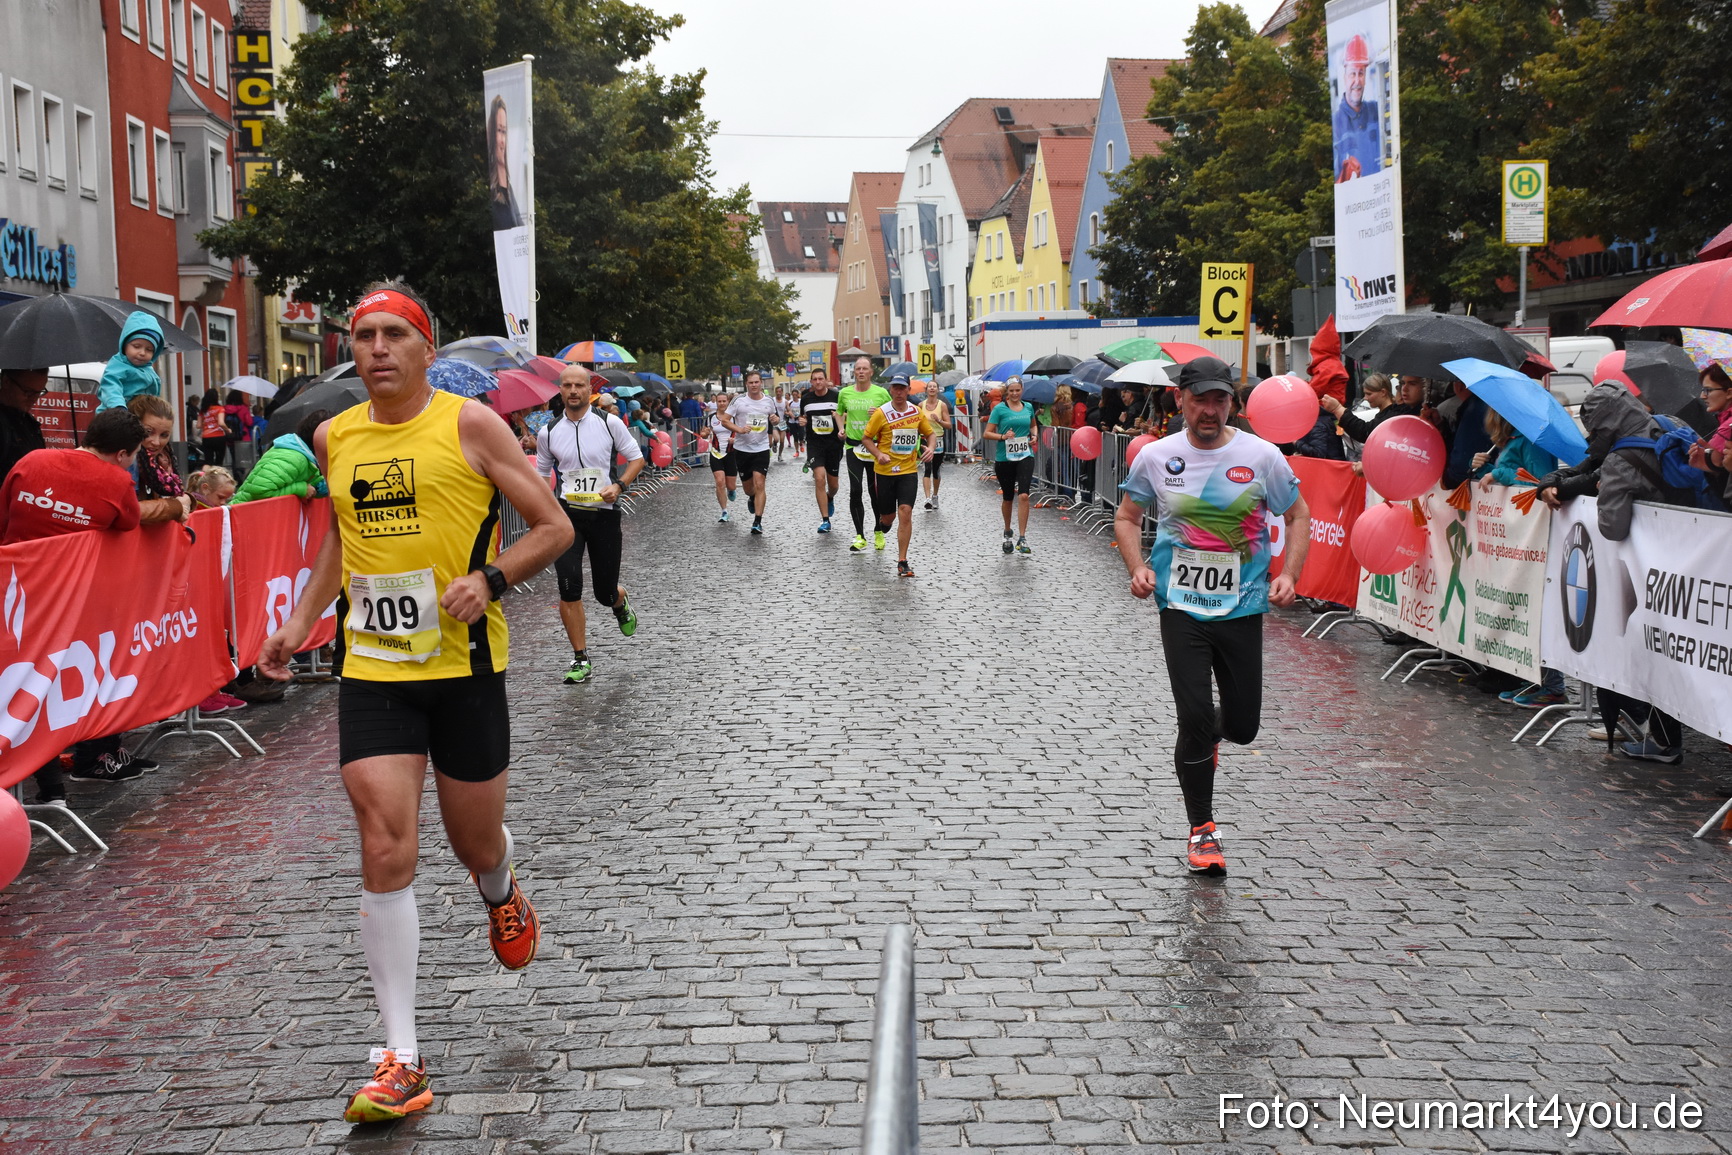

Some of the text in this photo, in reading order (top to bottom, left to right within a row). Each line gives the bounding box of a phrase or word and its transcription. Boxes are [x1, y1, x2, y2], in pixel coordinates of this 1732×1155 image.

[237, 35, 274, 217] HOTE
[1208, 266, 1247, 281] Block
[1213, 286, 1239, 324] C
[670, 359, 680, 373] D
[922, 353, 931, 367] D
[889, 421, 906, 430] MAX
[895, 435, 916, 445] 2688
[1384, 437, 1431, 460] RÖDL
[1230, 470, 1252, 479] Hervis
[574, 477, 597, 492] 317
[17, 487, 91, 519] RÖDL
[52, 512, 90, 526] energie
[356, 507, 418, 523] HIRSCH
[360, 524, 421, 534] APOTHEKE
[1200, 553, 1234, 562] BOCK
[374, 573, 424, 589] BOCK
[1177, 564, 1233, 591] 2704
[1184, 594, 1222, 607] Matthias
[1645, 568, 1695, 620] BMW
[363, 595, 419, 632] 209
[1644, 624, 1696, 665] WENIGER
